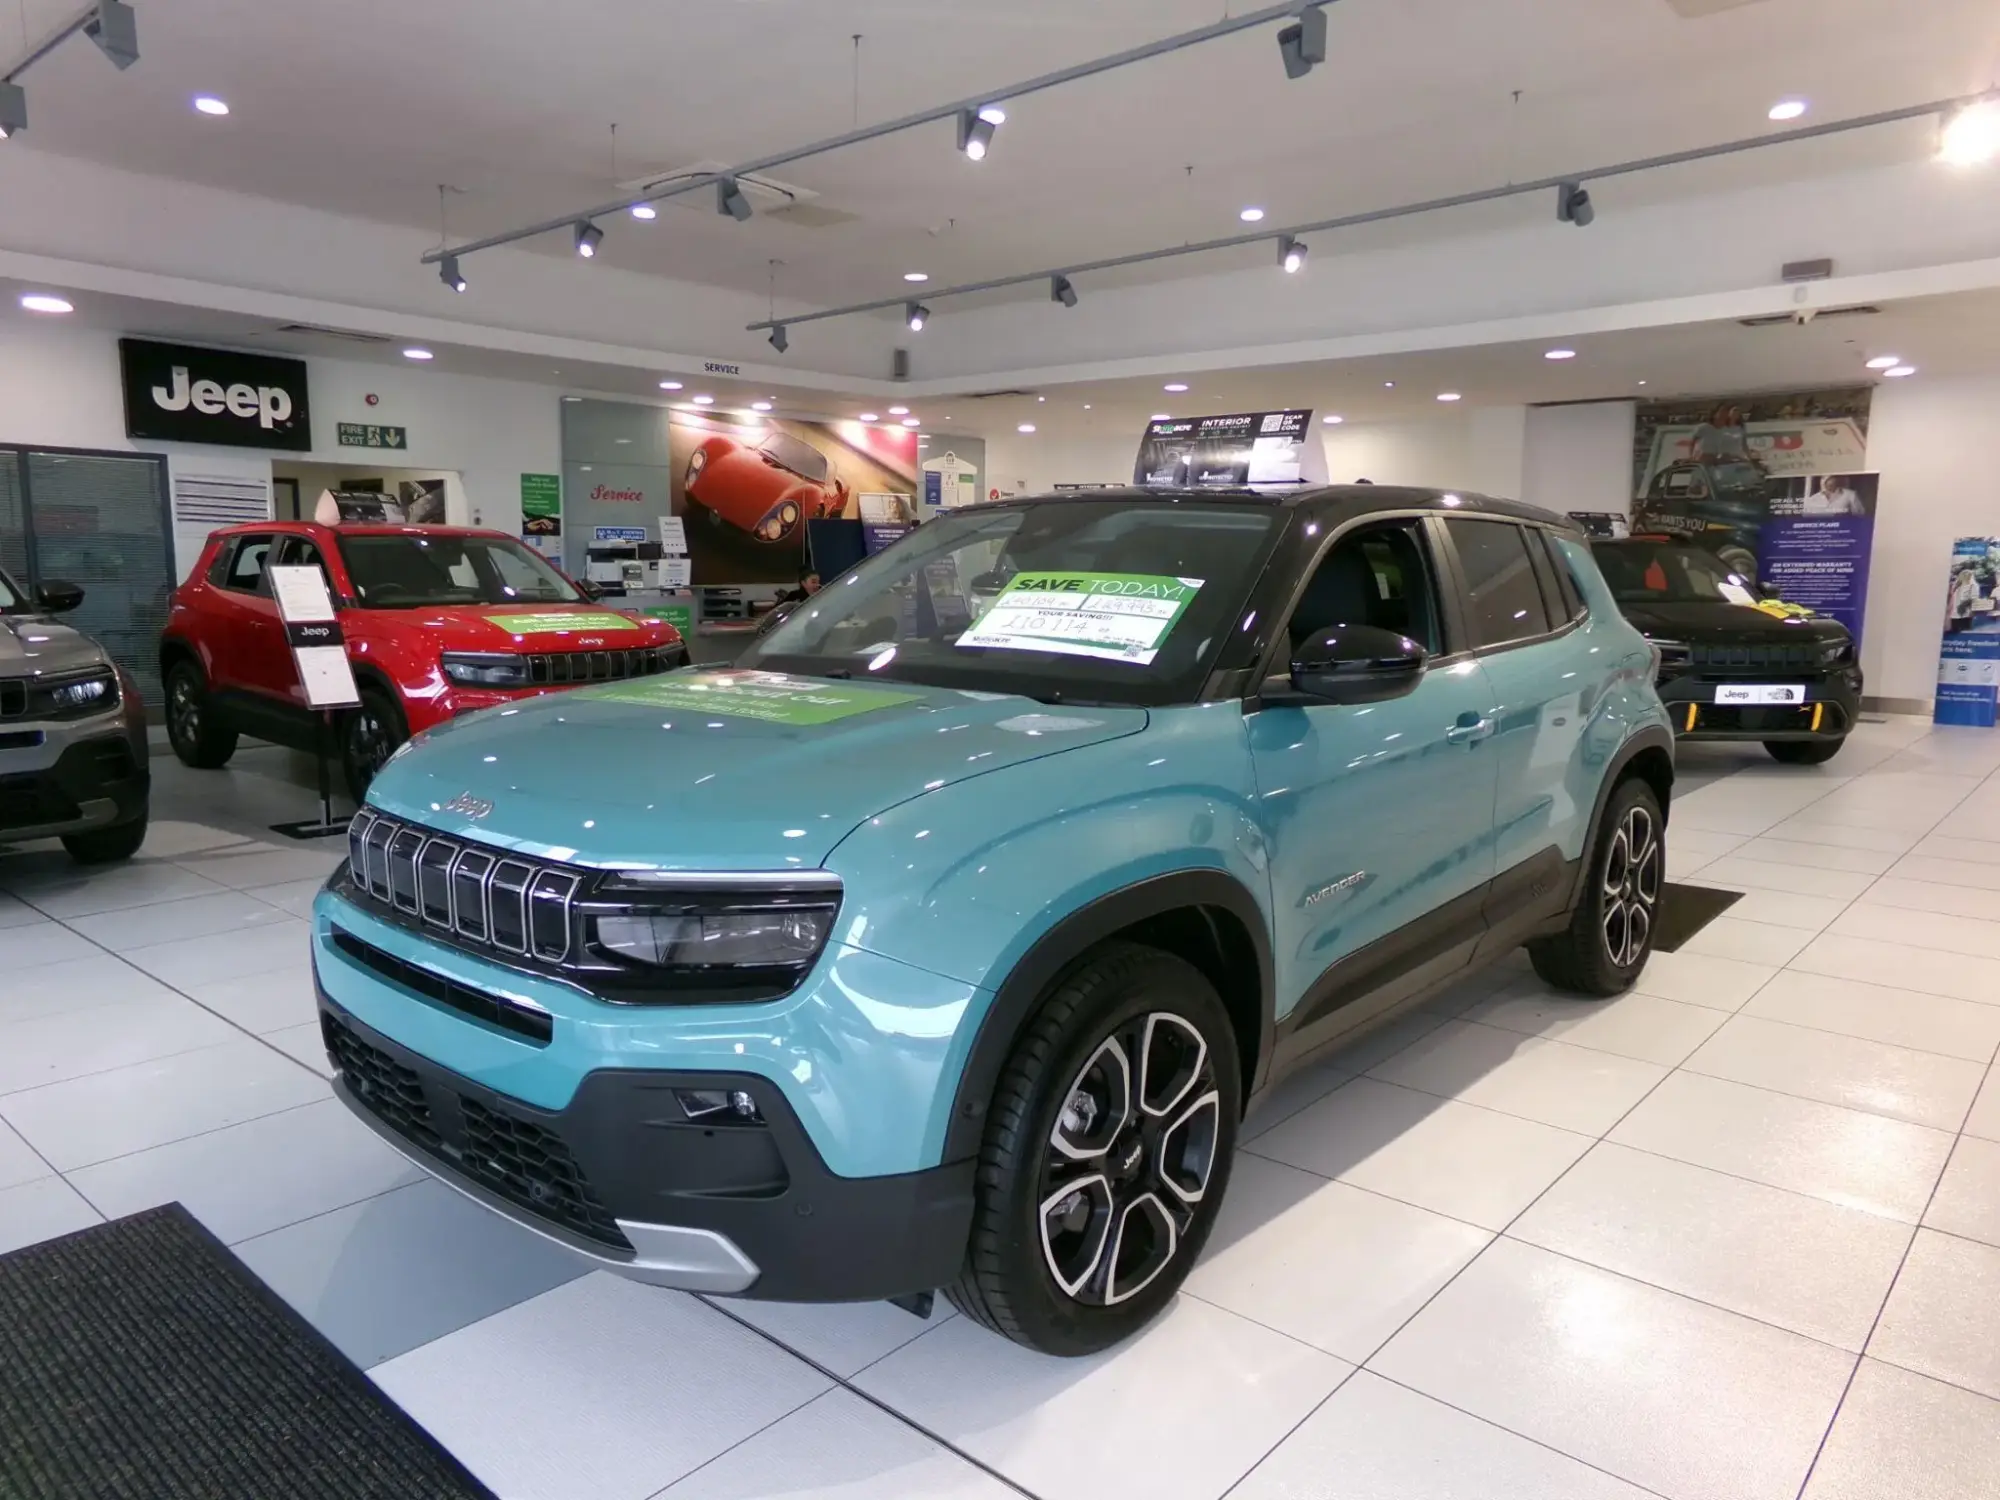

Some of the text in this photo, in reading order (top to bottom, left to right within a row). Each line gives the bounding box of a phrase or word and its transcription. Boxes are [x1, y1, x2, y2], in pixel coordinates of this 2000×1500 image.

[704, 362, 740, 375] SERVICE
[152, 365, 292, 429] Jeep
[1202, 417, 1251, 426] INTERIOR
[341, 425, 364, 435] FIRE
[342, 435, 364, 445] EXIT
[590, 483, 644, 502] Service
[1687, 518, 1707, 531] YOU
[1014, 578, 1084, 591] SAVE
[1089, 579, 1187, 600] TODAY!
[1066, 612, 1113, 620] SAVING!!!
[301, 626, 330, 637] Jeep
[578, 637, 604, 646] Jeep
[1725, 690, 1750, 700] Jeep
[445, 790, 494, 822] Jeep
[1304, 870, 1365, 908] AVENGER
[1123, 1145, 1141, 1169] Jeep
